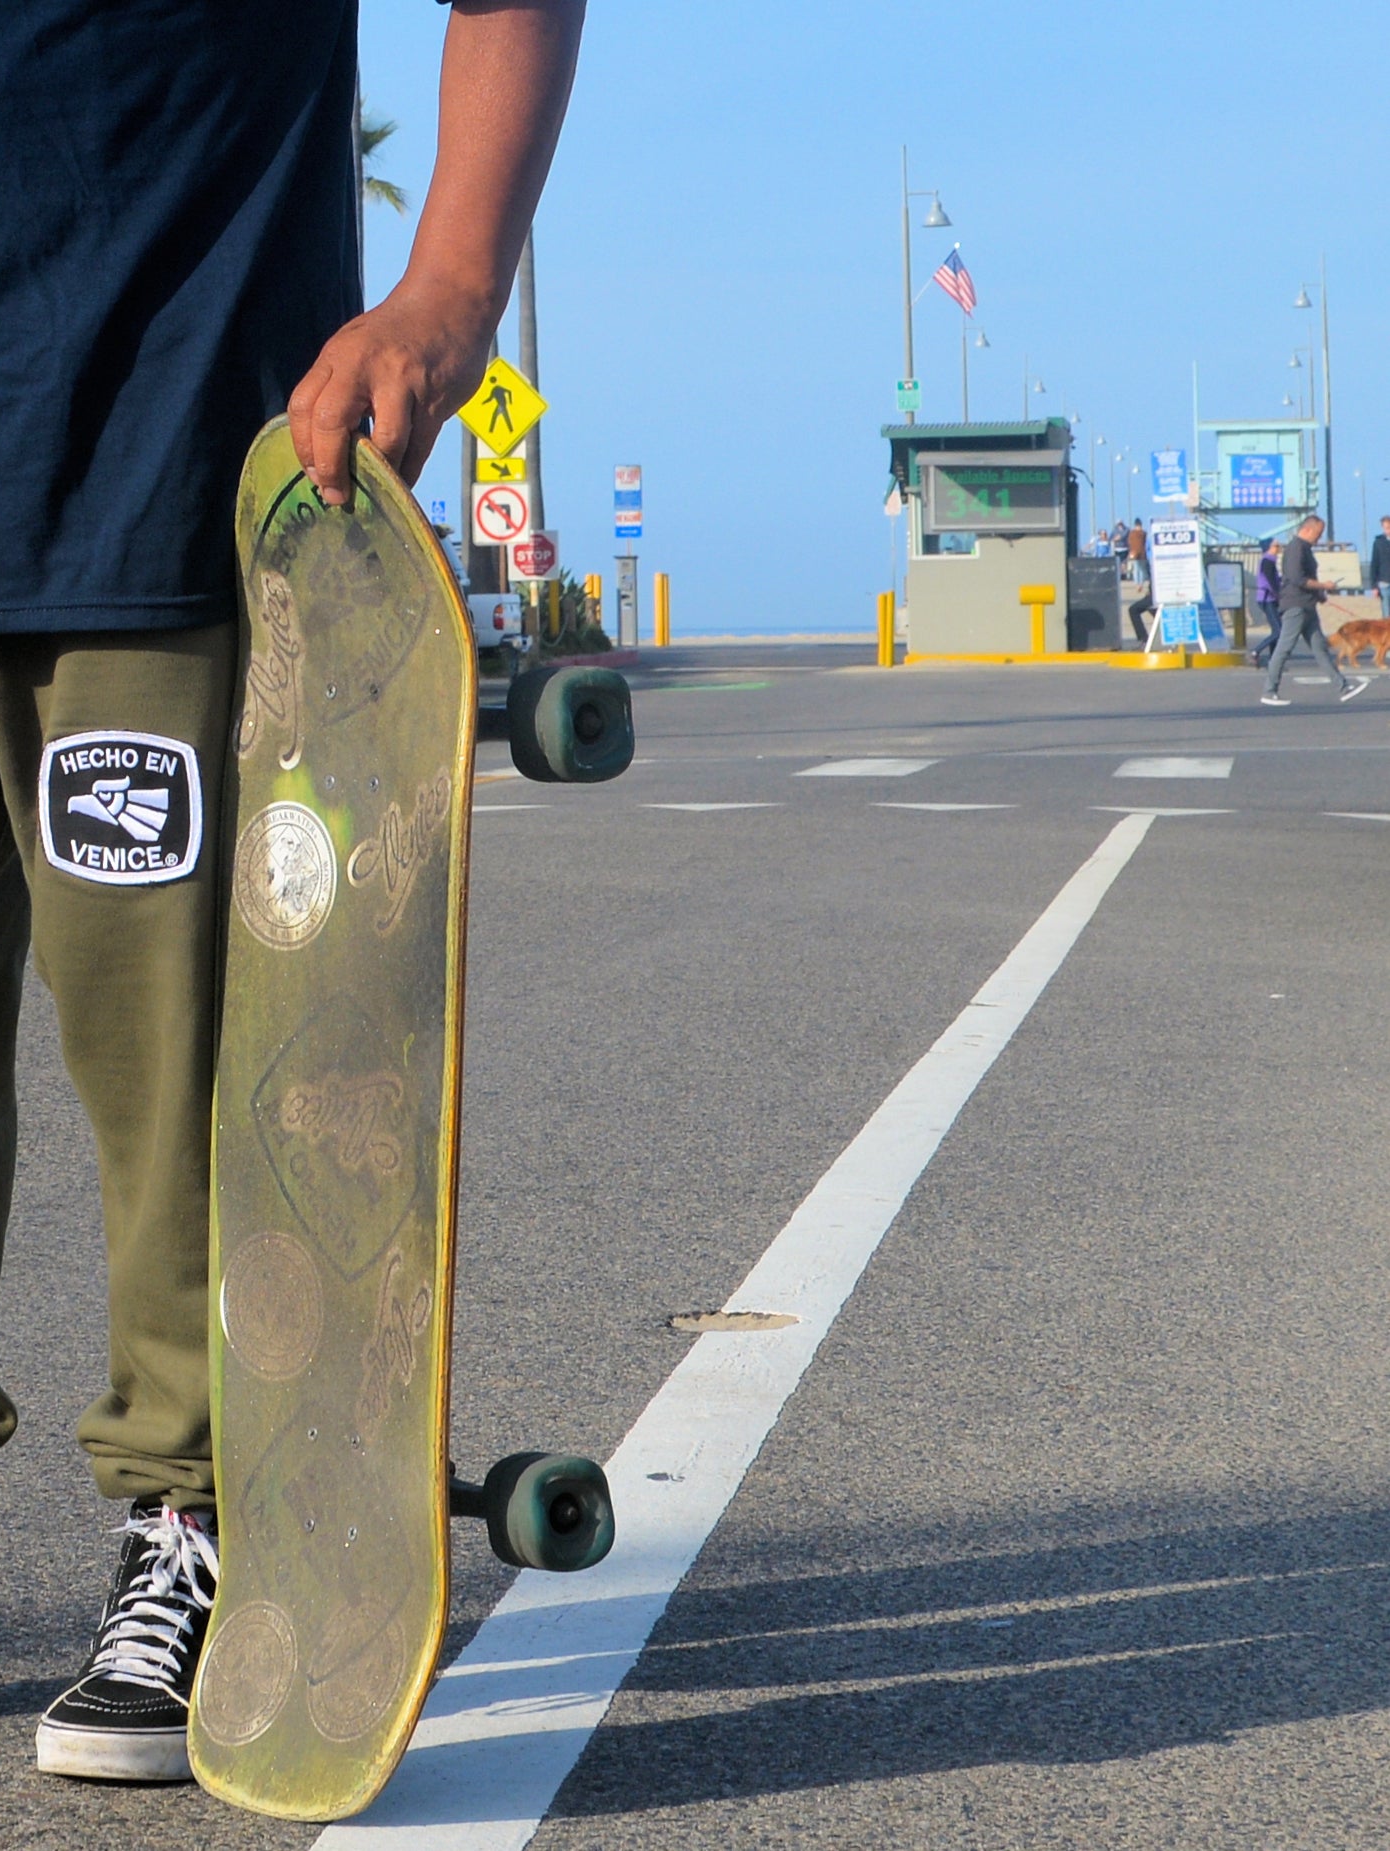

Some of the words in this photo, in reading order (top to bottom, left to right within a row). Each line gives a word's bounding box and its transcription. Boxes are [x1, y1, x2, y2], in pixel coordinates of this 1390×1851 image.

[946, 488, 1014, 519] 341
[1157, 531, 1191, 544] $4.00
[516, 550, 551, 562] STOP
[60, 748, 139, 775] HECHO
[145, 751, 178, 776] EN
